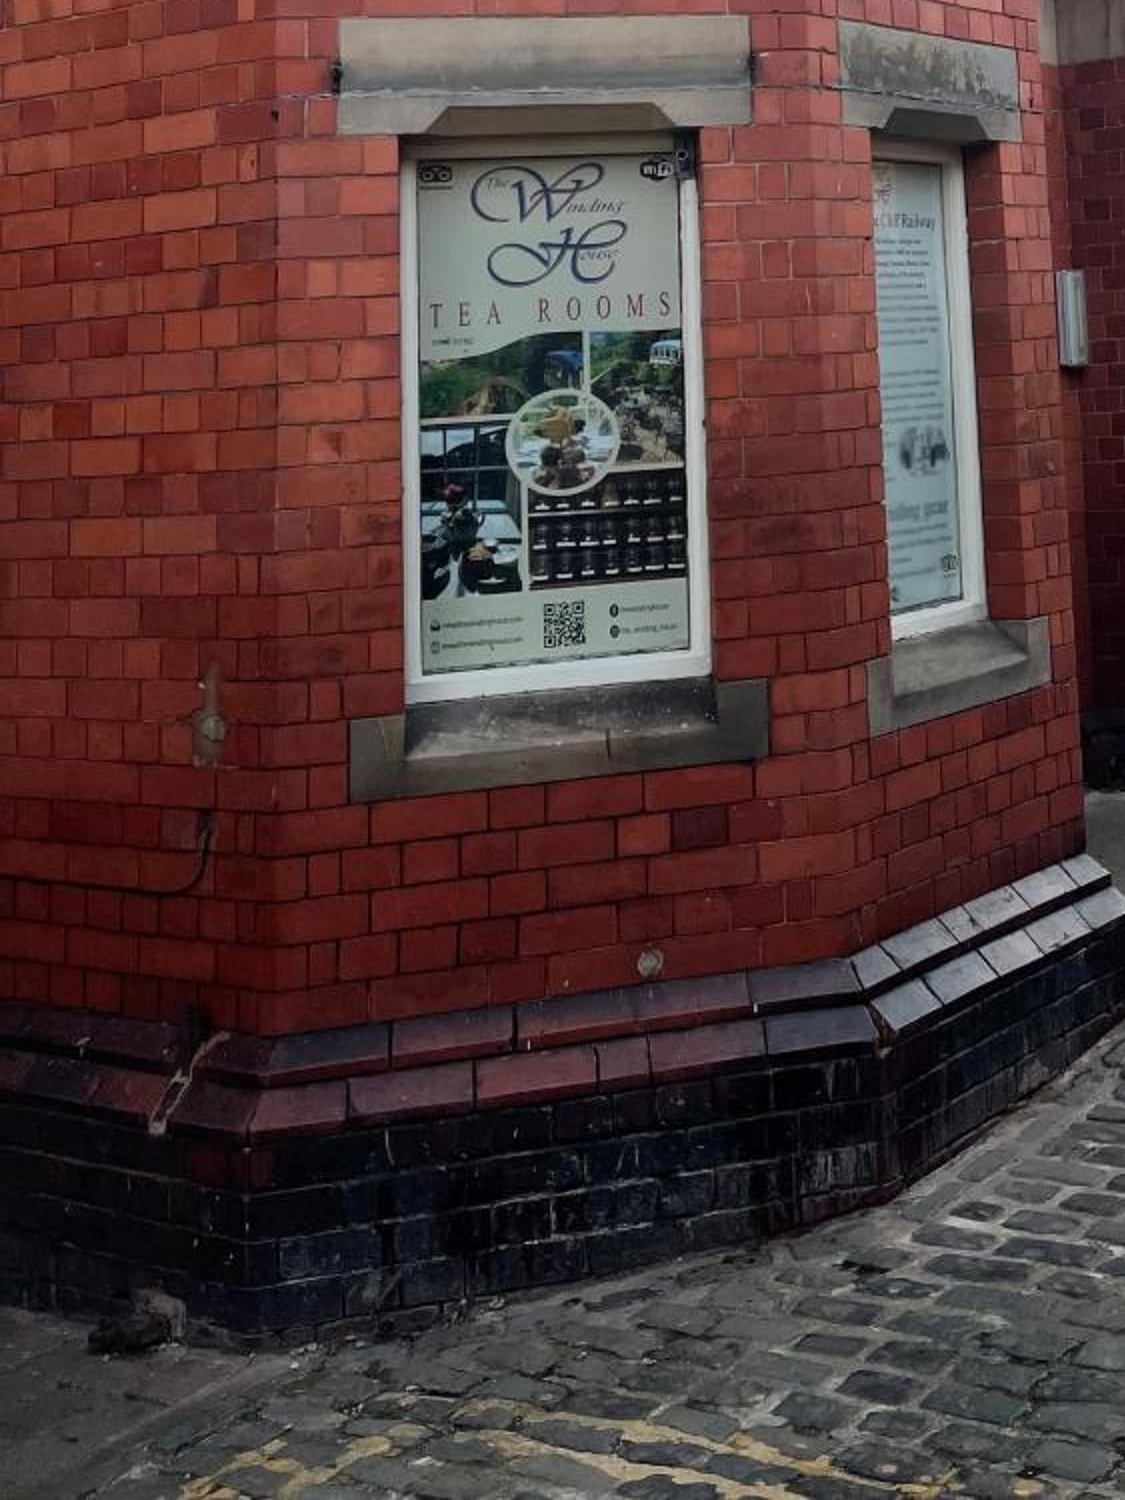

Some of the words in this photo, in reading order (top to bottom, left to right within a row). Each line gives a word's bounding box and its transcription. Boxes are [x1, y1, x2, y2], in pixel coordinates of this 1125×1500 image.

[470, 162, 626, 223] Winding
[487, 219, 628, 287] House
[429, 302, 501, 329] TEA
[538, 291, 671, 323] ROOMS
